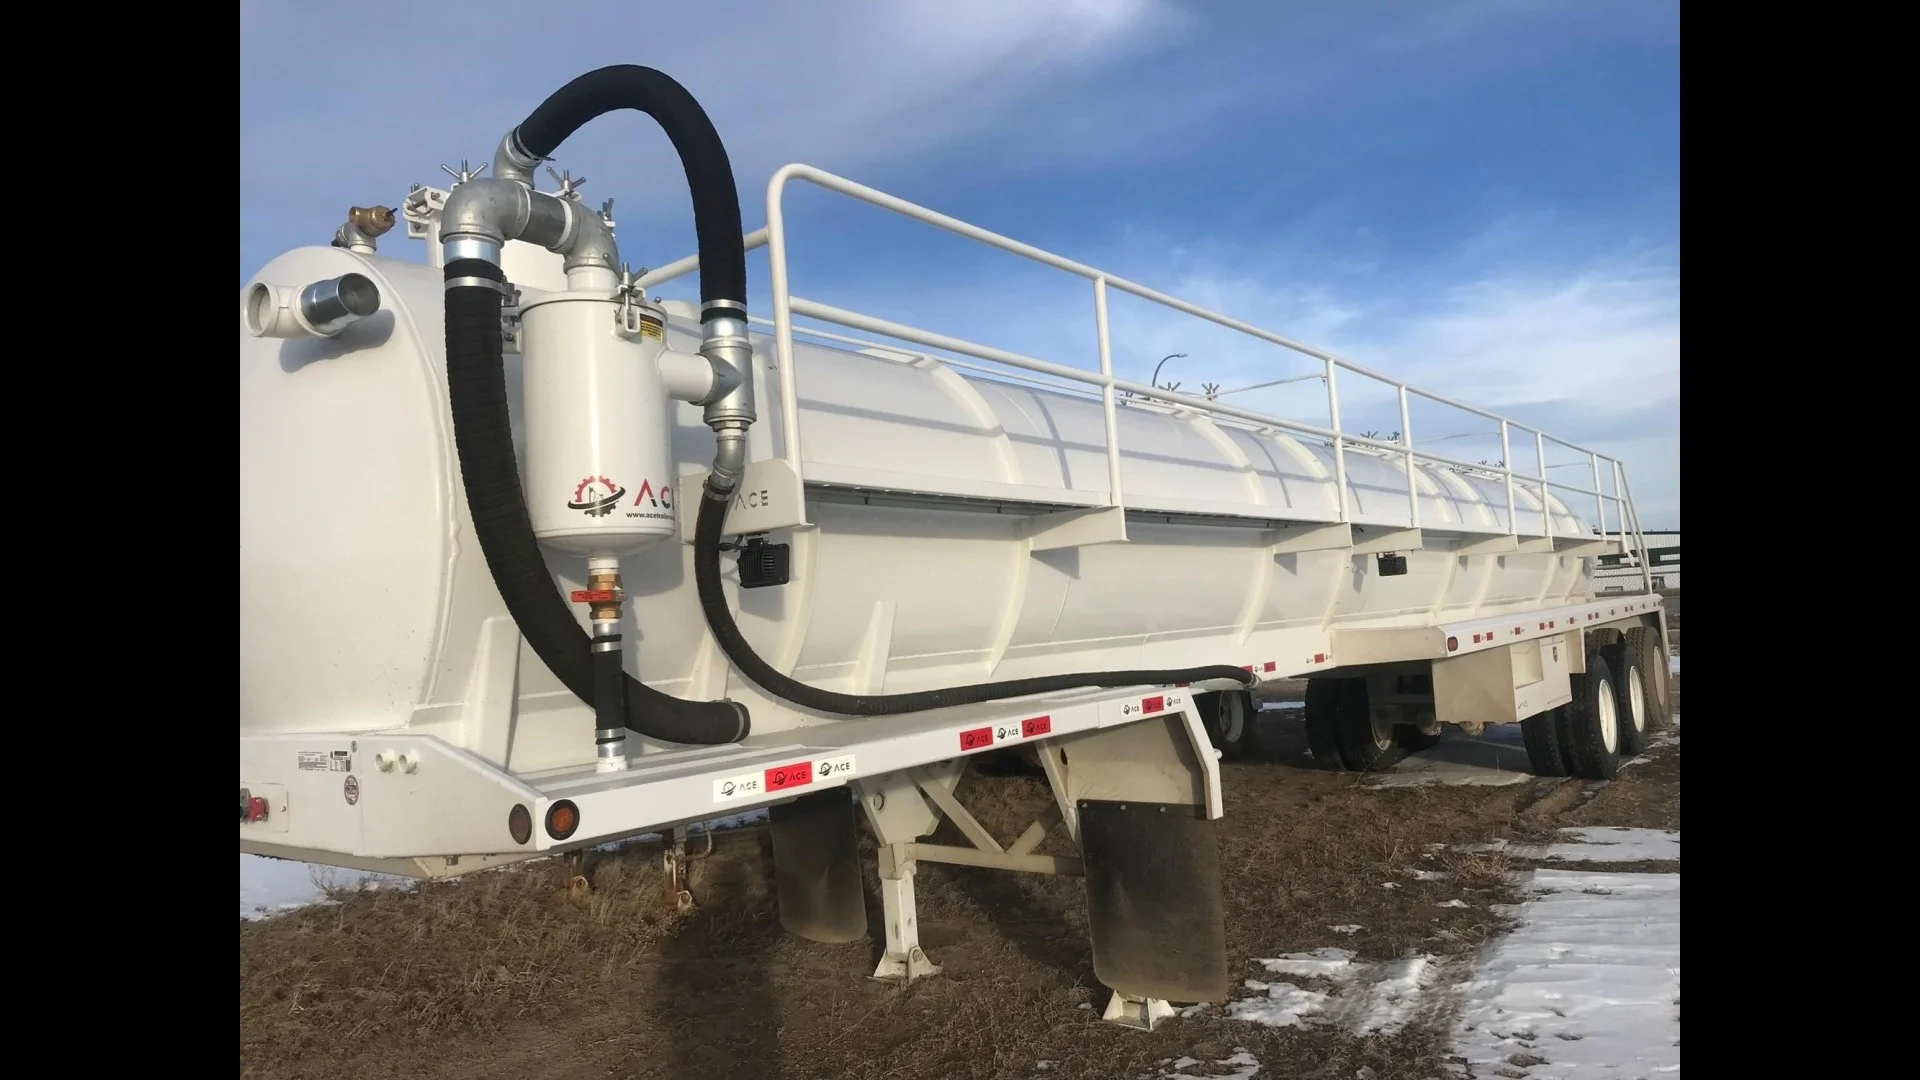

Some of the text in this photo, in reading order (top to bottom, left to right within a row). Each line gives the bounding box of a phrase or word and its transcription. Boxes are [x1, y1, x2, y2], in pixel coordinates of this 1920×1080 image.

[634, 478, 675, 510] AC
[735, 489, 769, 511] ACE
[1007, 728, 1019, 737] ACE
[976, 735, 989, 743] ACE
[834, 762, 850, 772] ACE
[789, 771, 807, 782] ACE
[739, 780, 757, 792] ACE
